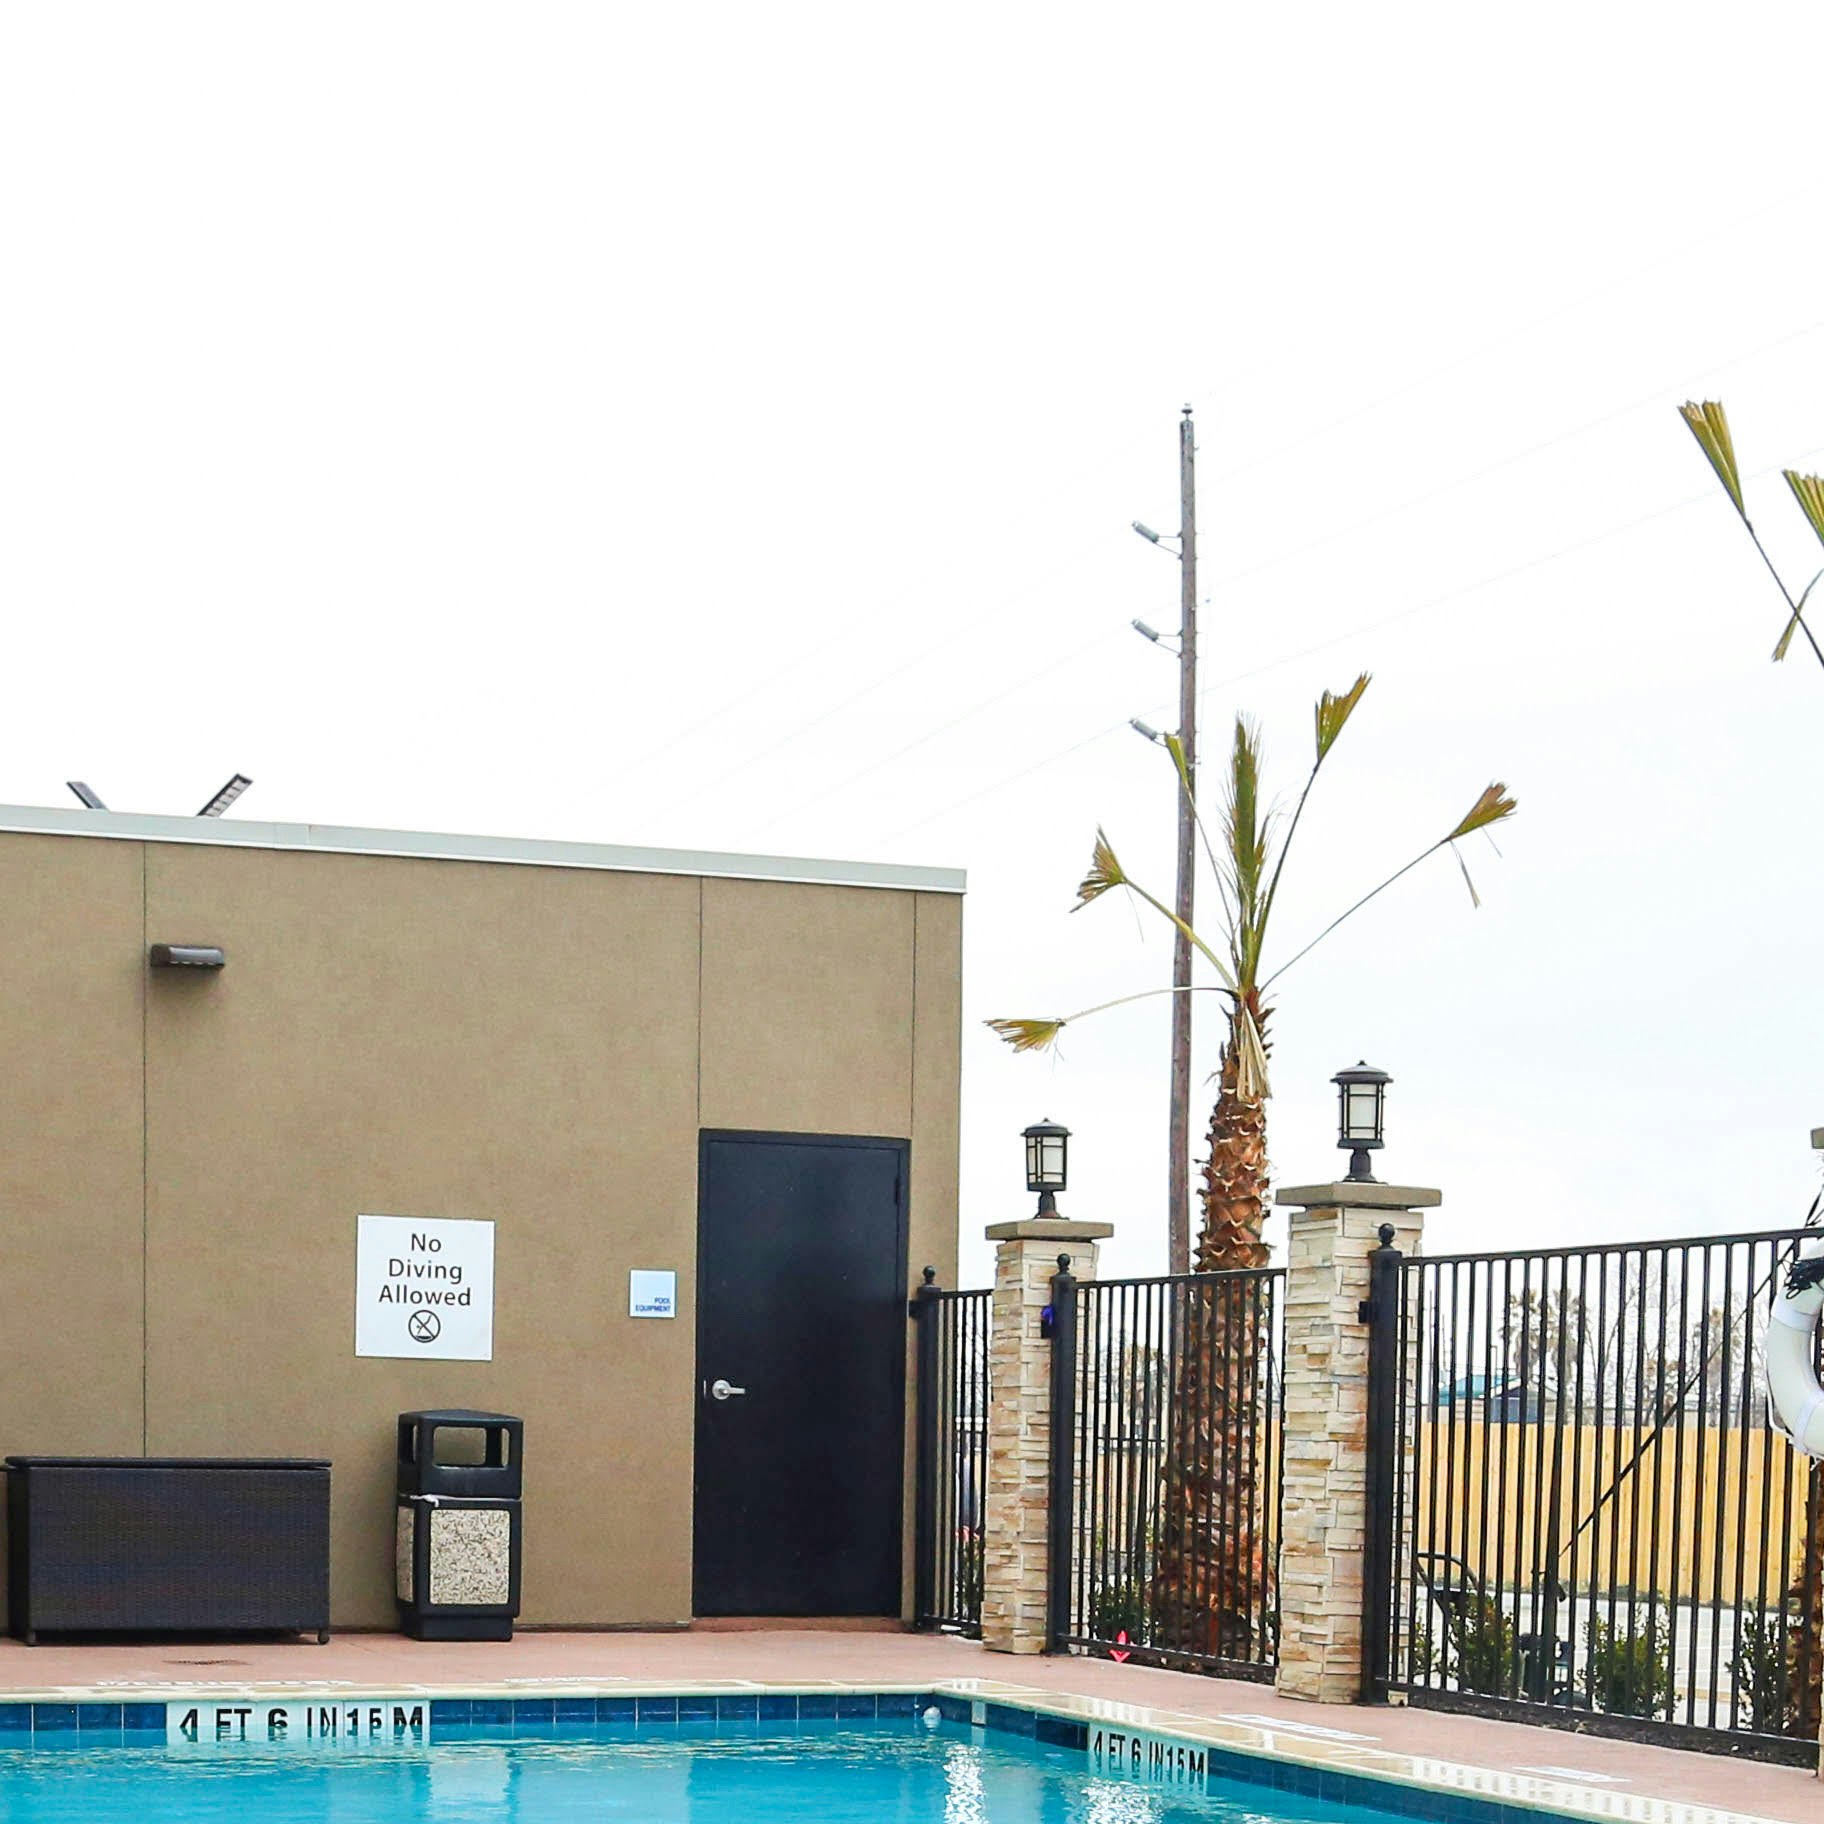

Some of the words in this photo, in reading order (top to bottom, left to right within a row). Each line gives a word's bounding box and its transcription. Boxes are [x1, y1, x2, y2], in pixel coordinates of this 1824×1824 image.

[411, 1232, 443, 1253] No
[388, 1257, 463, 1285] Diving
[378, 1283, 472, 1307] Allowed
